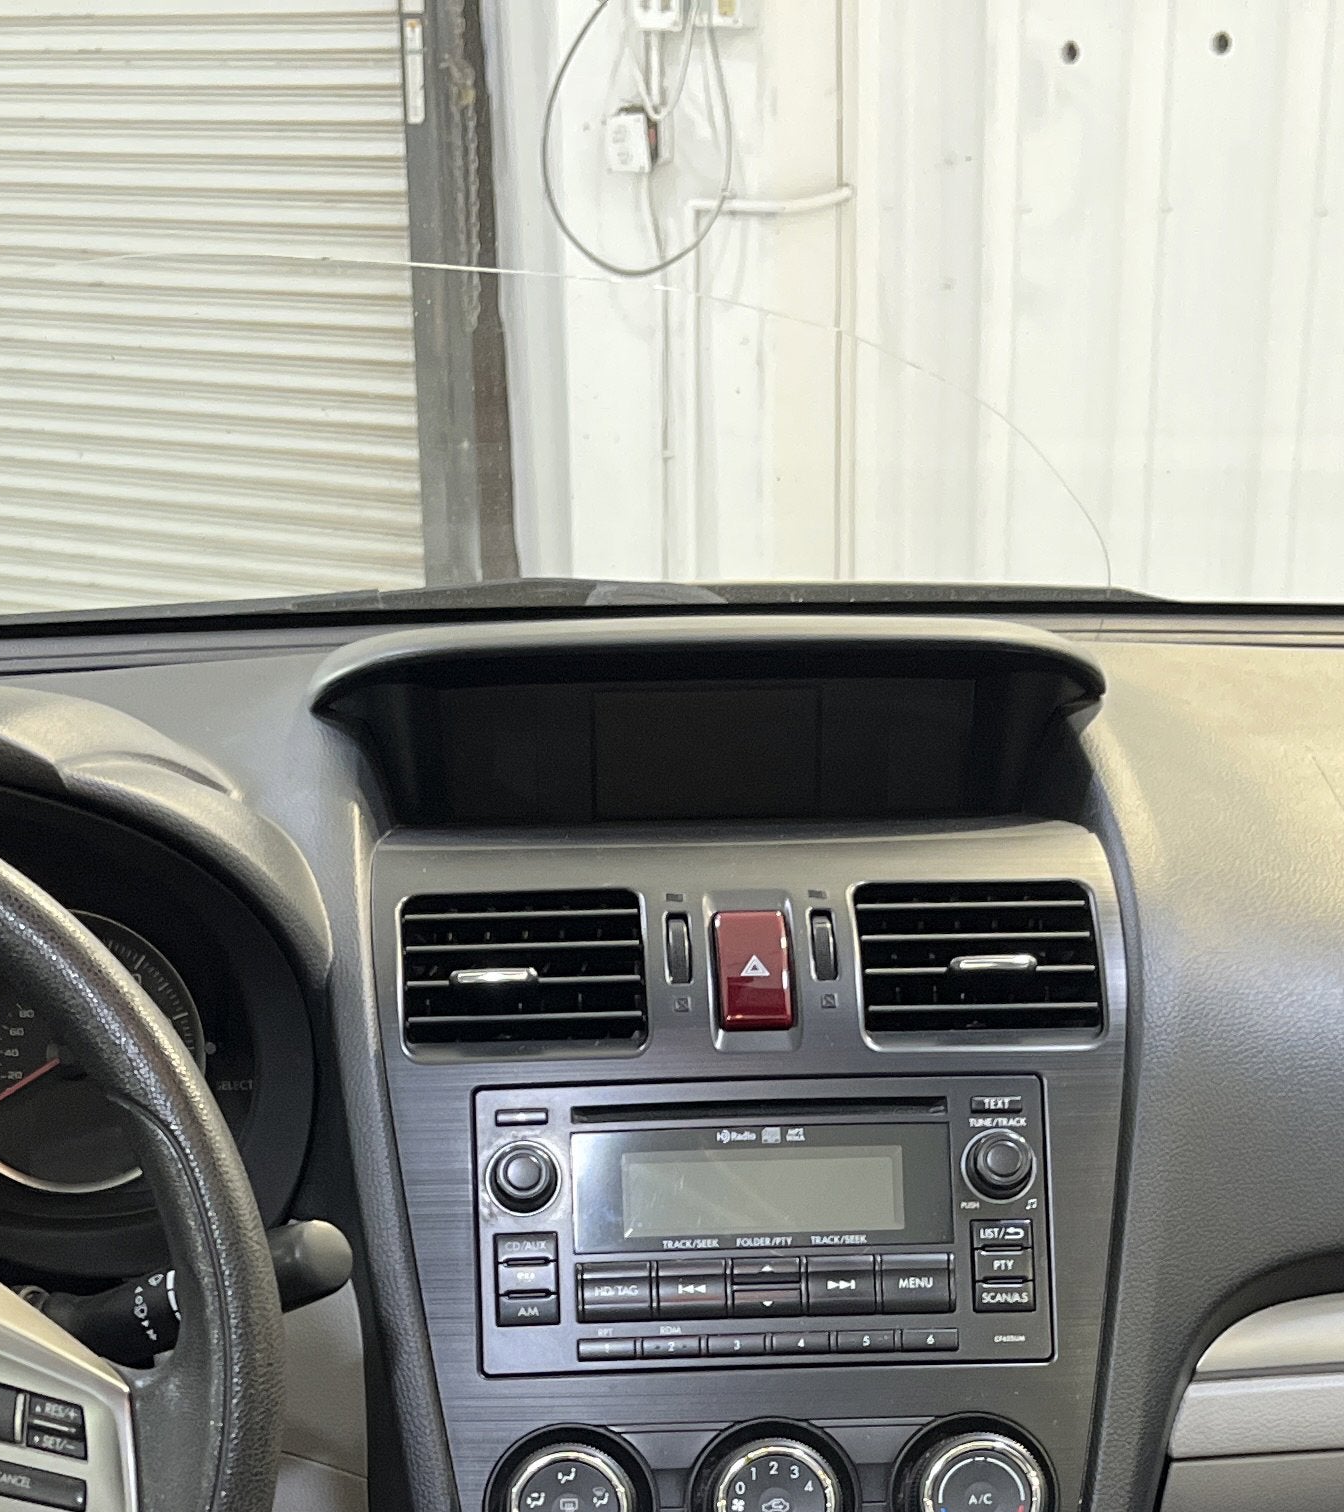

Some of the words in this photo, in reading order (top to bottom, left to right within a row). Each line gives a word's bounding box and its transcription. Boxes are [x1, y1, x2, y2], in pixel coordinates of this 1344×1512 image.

[9, 1027, 25, 1036] 60
[7, 1071, 23, 1080] 20
[983, 1099, 1009, 1109] TEXT
[969, 1117, 1026, 1127] TUNE/TRACK
[731, 1130, 757, 1142] Radio
[663, 1238, 719, 1248] TRACK/SEEK
[736, 1236, 792, 1247] FOLDER/PTY
[810, 1234, 867, 1245] TRACK/SEEK
[504, 1240, 547, 1252] CD/AUX
[993, 1260, 1013, 1271] PTY
[899, 1276, 933, 1290] MENU
[594, 1283, 639, 1297] HD/TAG
[518, 1306, 539, 1317] AM
[797, 1337, 805, 1349] 4
[862, 1336, 870, 1347] 5
[926, 1334, 934, 1345] 6
[668, 1342, 674, 1352] 2
[733, 1340, 740, 1351] 3
[750, 1468, 757, 1480] 1
[769, 1462, 779, 1475] 2
[789, 1466, 800, 1479] 3
[735, 1481, 746, 1494] 0
[804, 1480, 814, 1493] 4
[968, 1492, 993, 1506] A/C
